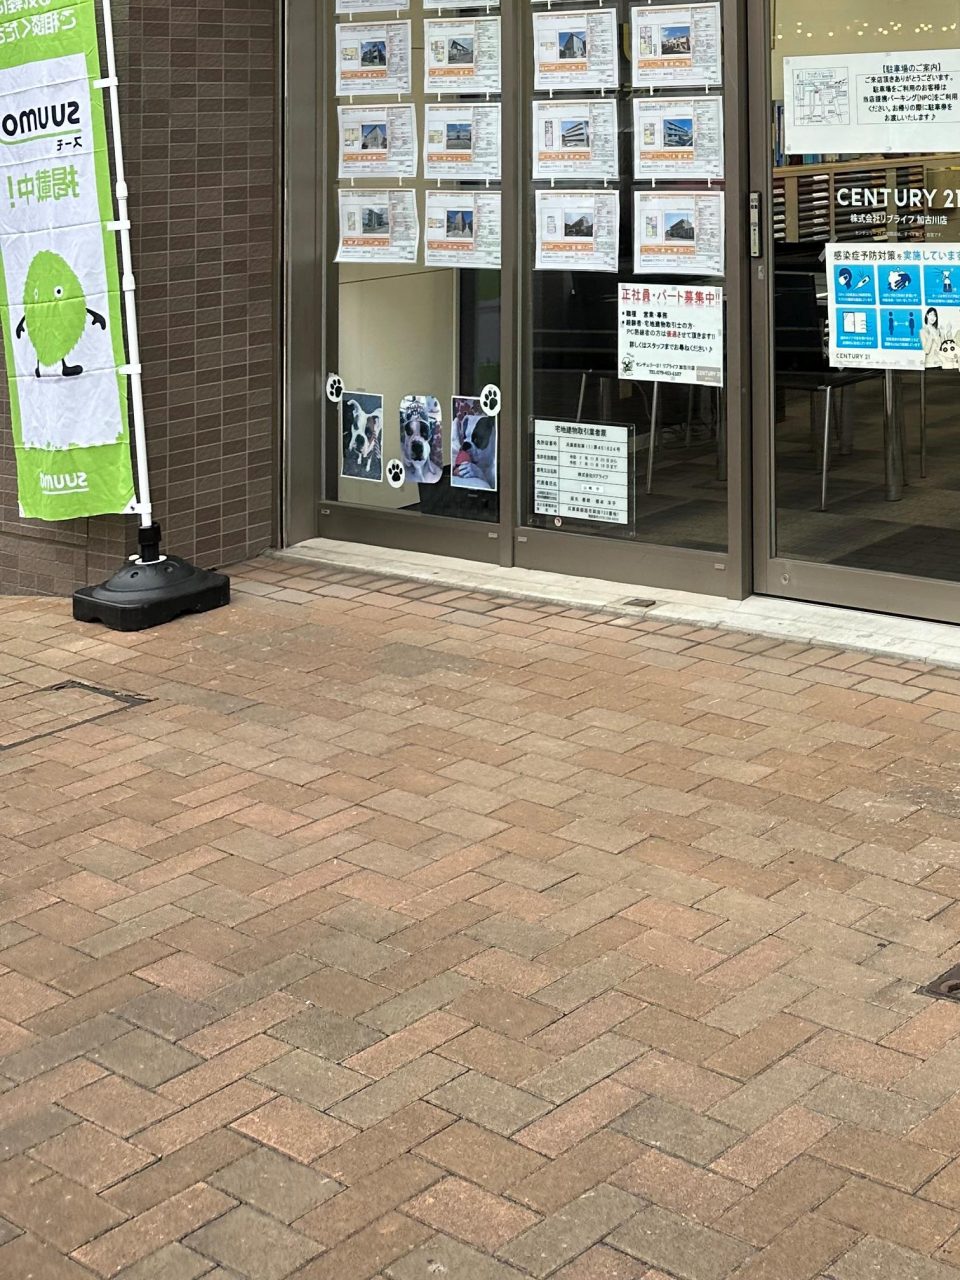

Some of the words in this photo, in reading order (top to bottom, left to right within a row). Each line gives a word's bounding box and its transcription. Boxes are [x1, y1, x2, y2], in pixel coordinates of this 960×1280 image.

[836, 187, 938, 207] CENTURY
[850, 213, 914, 224] 株式会社リブライフ
[917, 214, 948, 225] 加古川店
